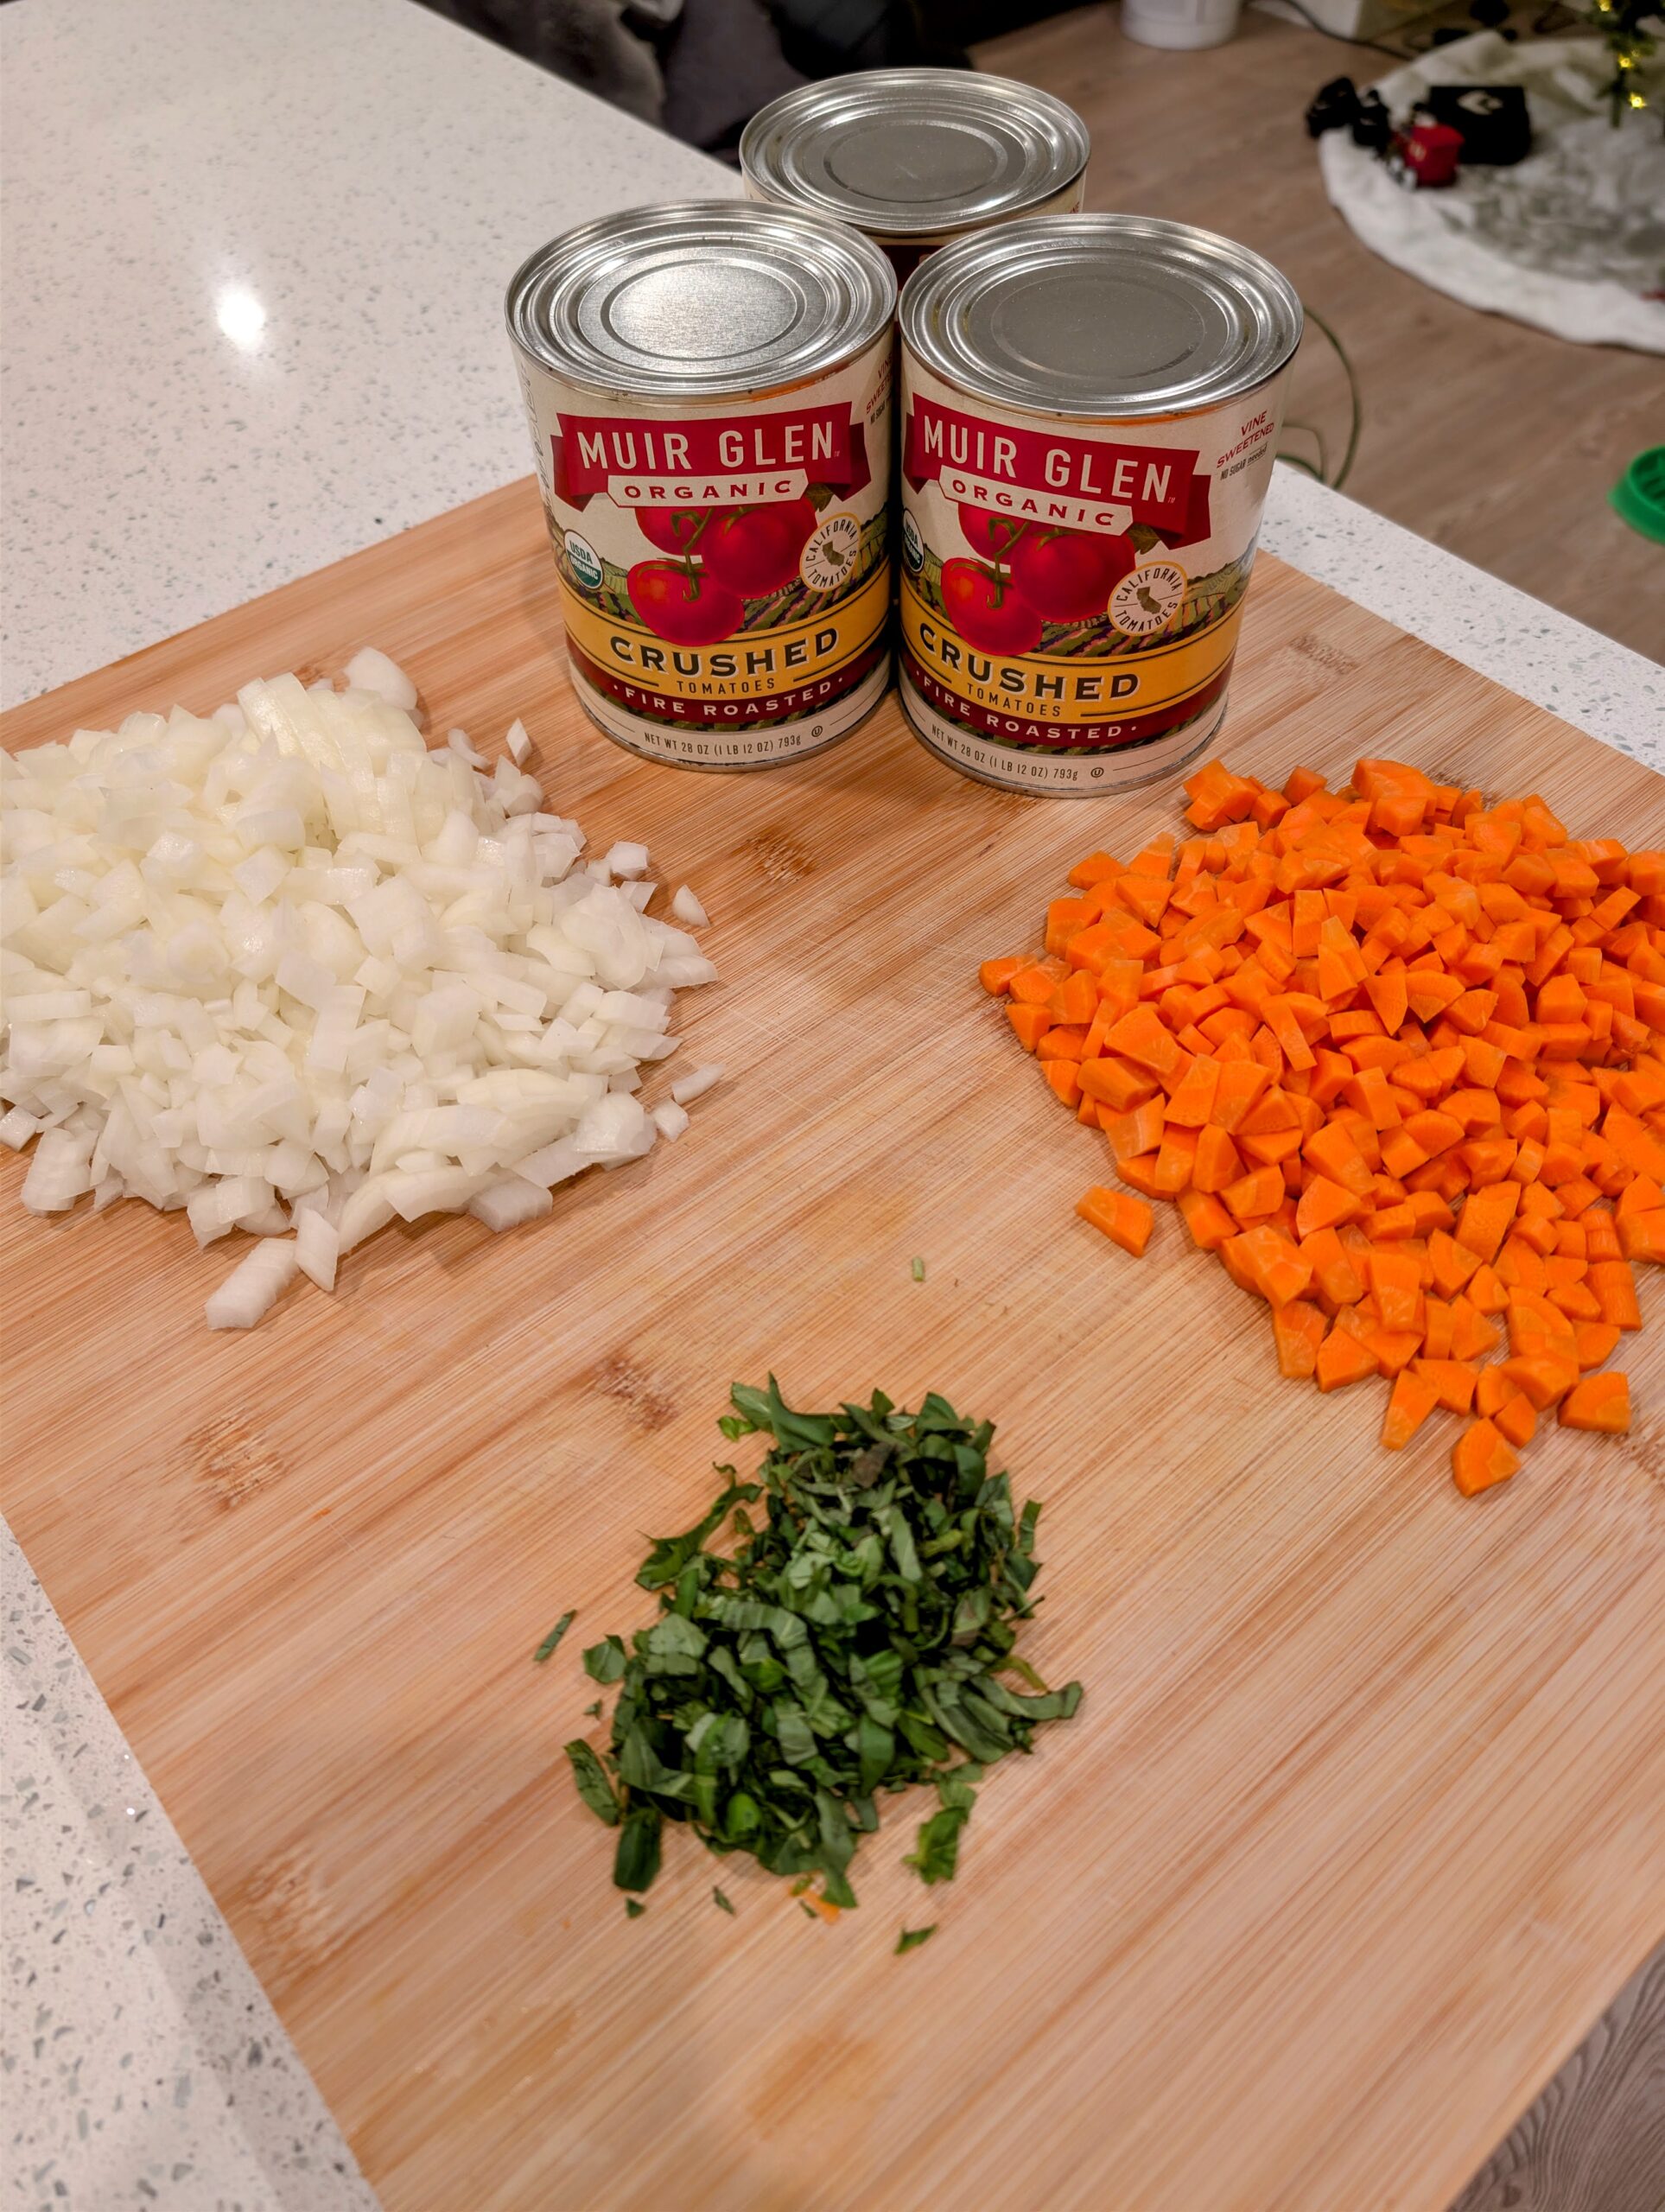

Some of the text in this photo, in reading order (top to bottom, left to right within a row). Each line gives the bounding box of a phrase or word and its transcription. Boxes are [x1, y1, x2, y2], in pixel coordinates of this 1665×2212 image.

[1241, 410, 1268, 435] VINE
[576, 431, 692, 470] MUIR
[719, 421, 832, 467] GLEN
[924, 416, 1016, 479] MUIR
[1045, 448, 1172, 503] GLEN
[1217, 423, 1274, 468] SWEETENED
[1229, 459, 1246, 476] SUGAR
[624, 480, 791, 499] ORGANIC
[952, 480, 1115, 526] ORGANIC
[569, 540, 593, 564] USDA
[805, 519, 857, 562] CALIFORNIA
[569, 554, 599, 580] ORGANIC
[808, 550, 857, 588] TOMATOES
[1116, 568, 1182, 601] CALIFORNIA
[1115, 601, 1179, 632] TOMATOES
[610, 627, 839, 677] CRUSHED
[919, 622, 1141, 703] CRUSHED
[626, 682, 831, 715] FIRE ROASTED
[677, 677, 775, 695] TOMATOES
[967, 683, 1061, 717] TOMATOES
[924, 677, 1122, 739] FIRE ROASTED
[645, 732, 661, 747] NET
[664, 738, 677, 750] WT
[681, 742, 693, 753] 28
[697, 744, 709, 755] OZ
[727, 744, 739, 755] LB
[743, 743, 753, 753] 12
[757, 740, 773, 753] OZ)
[778, 735, 801, 748] 793g
[932, 725, 944, 742] NET
[947, 734, 958, 751] WT
[961, 743, 971, 757] 28
[975, 750, 985, 764] OZ
[1001, 760, 1013, 772] LB
[1017, 763, 1027, 775] 12
[1031, 765, 1048, 779] OZ)
[1053, 768, 1078, 781] 793g
